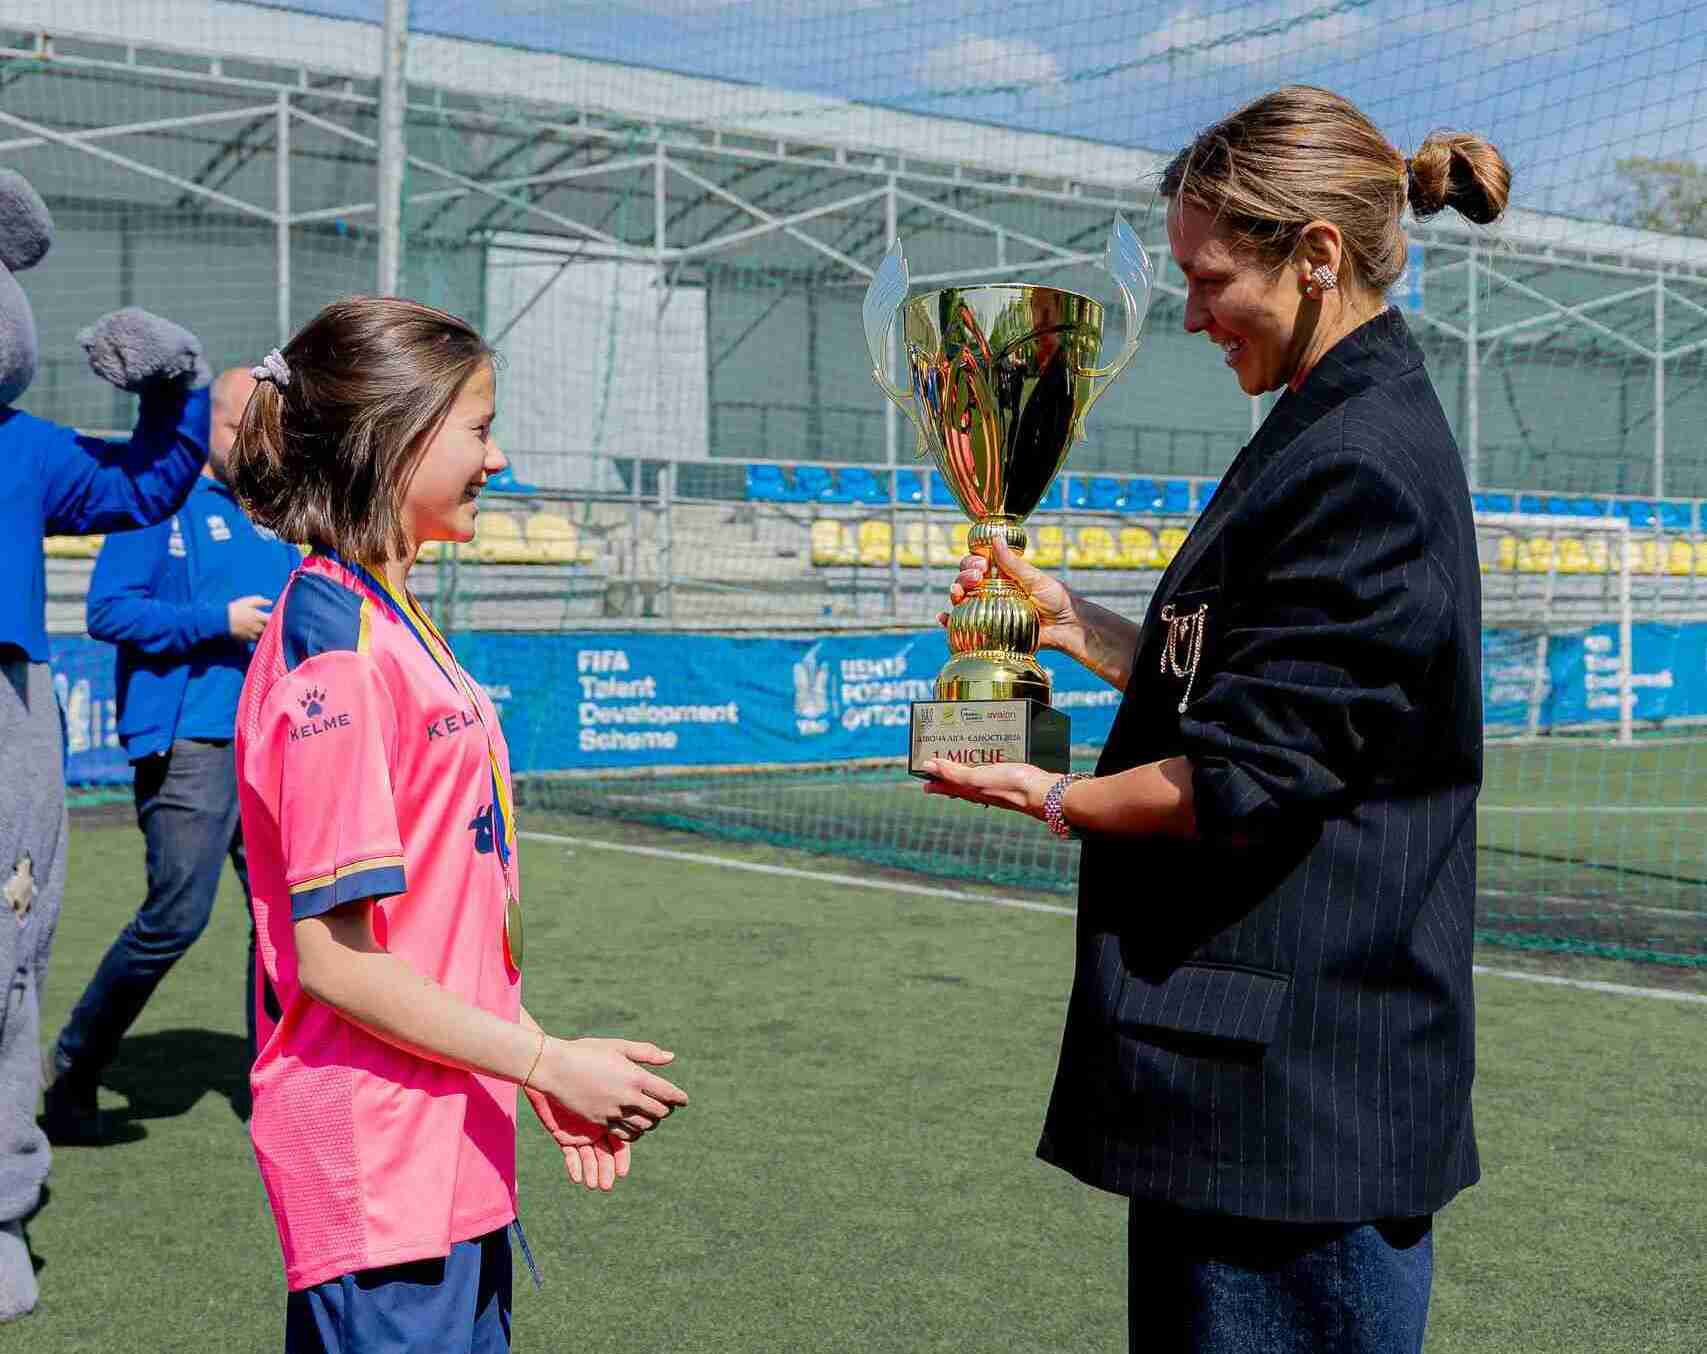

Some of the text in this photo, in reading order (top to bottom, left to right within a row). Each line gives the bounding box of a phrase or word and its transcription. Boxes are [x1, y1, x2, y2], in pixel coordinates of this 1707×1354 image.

[577, 650, 629, 672] FIFA
[578, 675, 656, 699] Talent
[579, 701, 739, 726] Development
[289, 713, 351, 742] KELME
[427, 711, 476, 741] KEL
[579, 728, 678, 751] Scheme
[946, 749, 1005, 764] МІСЦЕ
